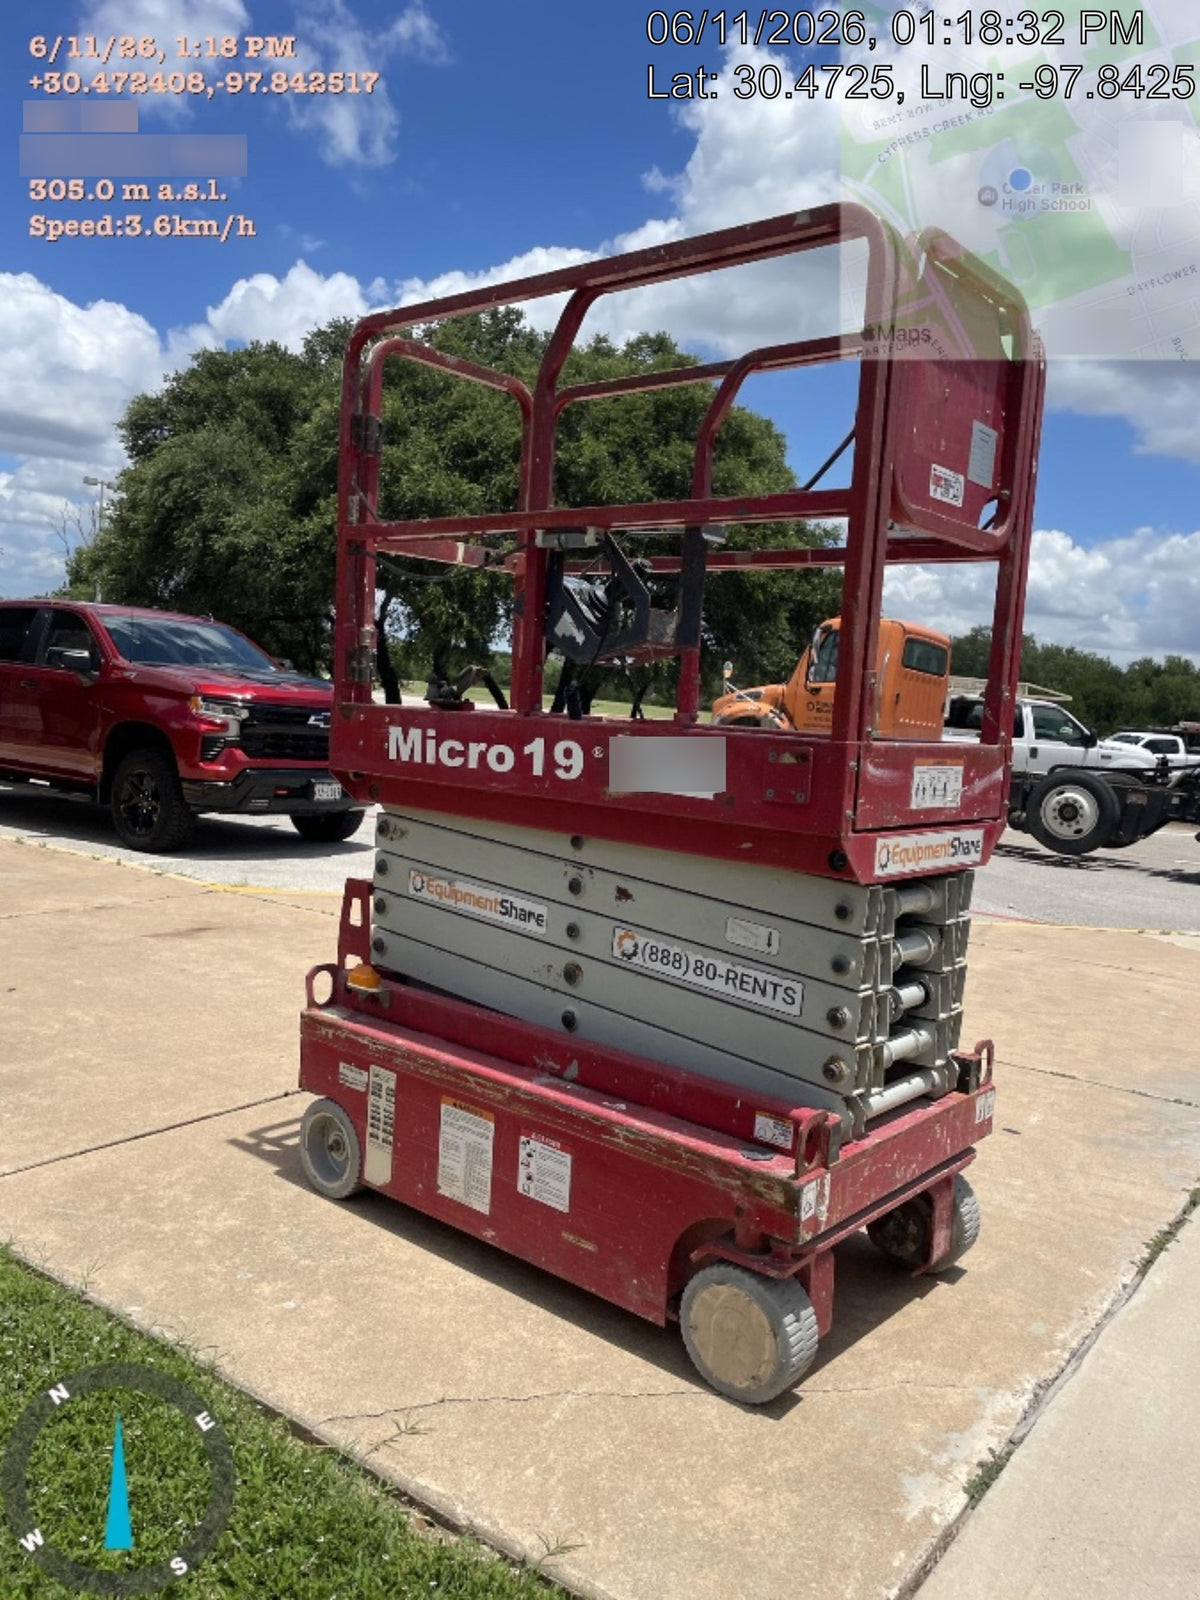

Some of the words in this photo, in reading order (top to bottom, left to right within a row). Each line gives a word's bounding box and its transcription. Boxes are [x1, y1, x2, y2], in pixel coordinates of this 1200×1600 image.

[388, 726, 515, 773] Micro
[523, 737, 585, 780] 19
[892, 837, 981, 867] EquipmentShare
[426, 878, 545, 927] EquipmentShare
[641, 942, 690, 976] (888)
[693, 960, 797, 1006] 80-RENTS
